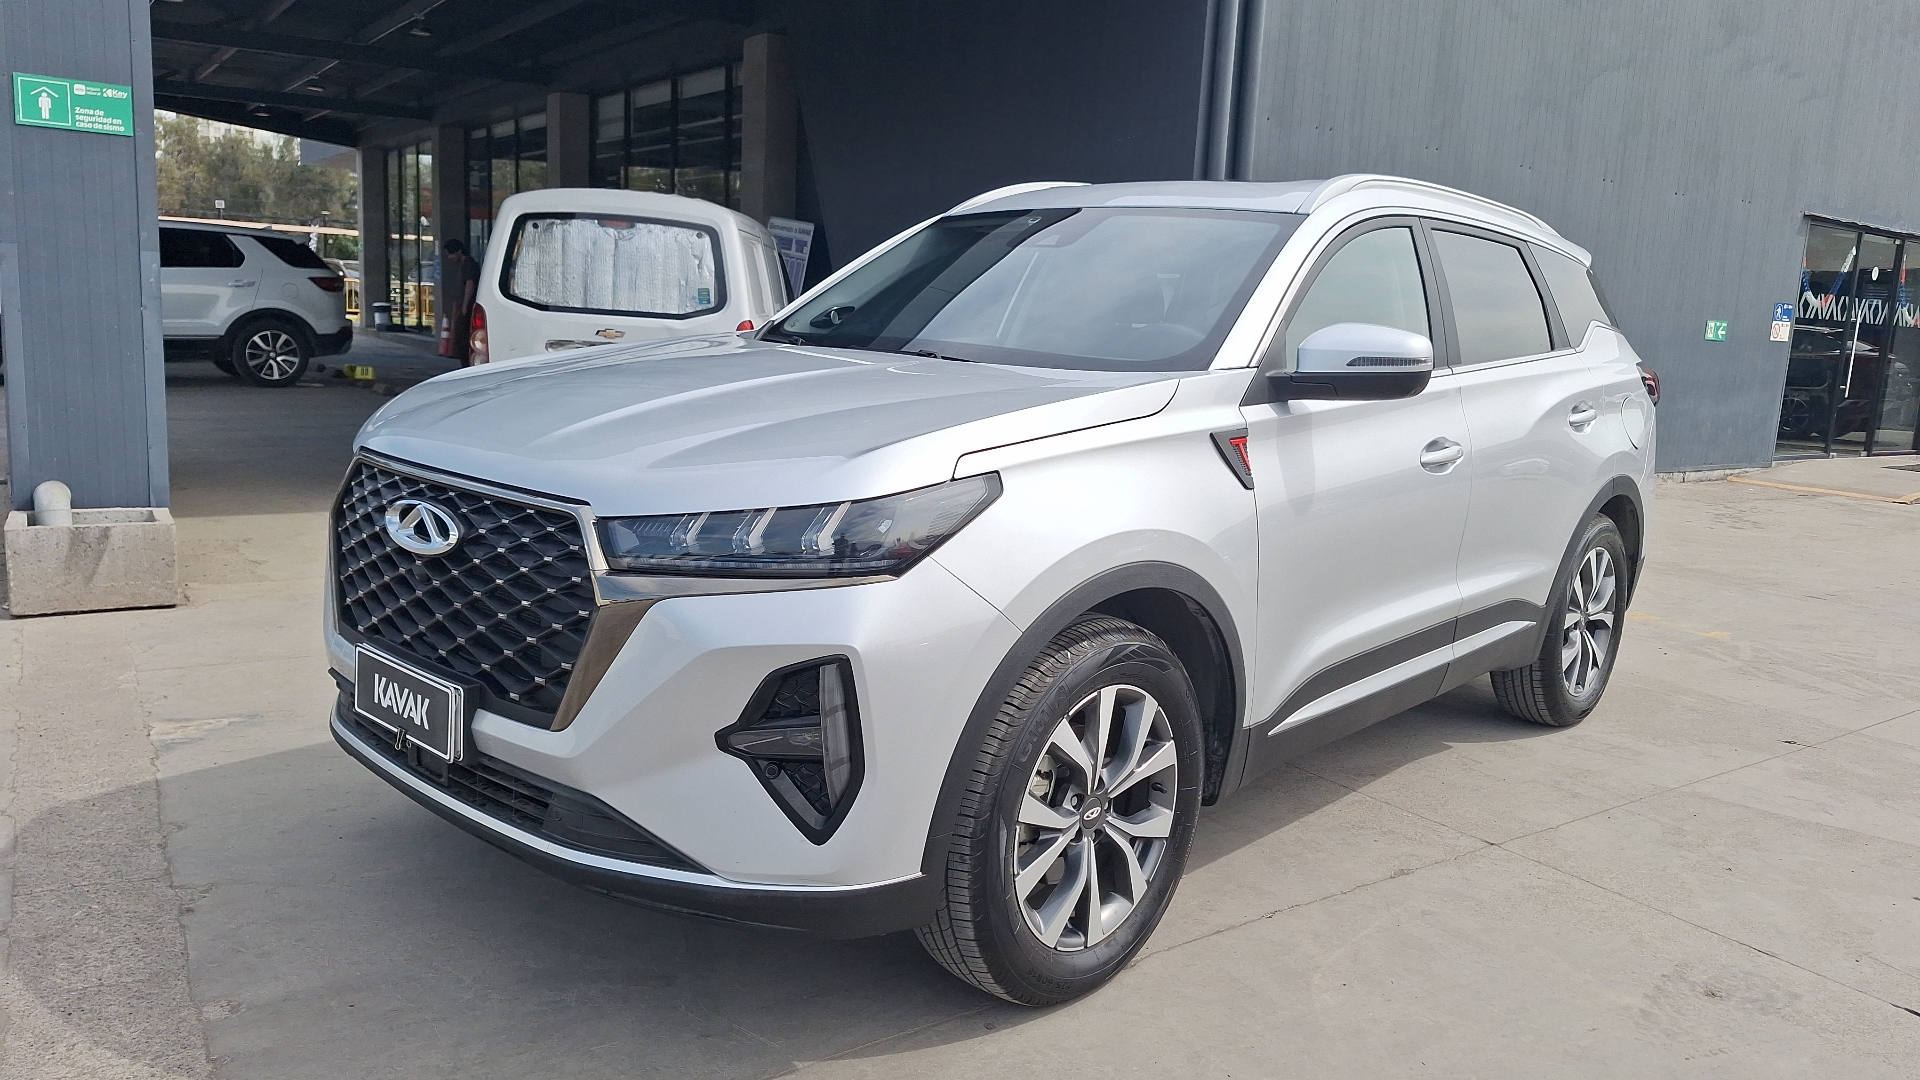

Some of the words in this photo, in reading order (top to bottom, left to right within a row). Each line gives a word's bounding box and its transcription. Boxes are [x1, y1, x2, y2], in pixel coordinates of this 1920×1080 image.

[112, 88, 128, 99] Key
[75, 106, 94, 115] Zona
[75, 114, 112, 124] seguridad
[76, 121, 93, 129] caso
[103, 124, 125, 132] sismo
[374, 673, 430, 731] KAVAK
